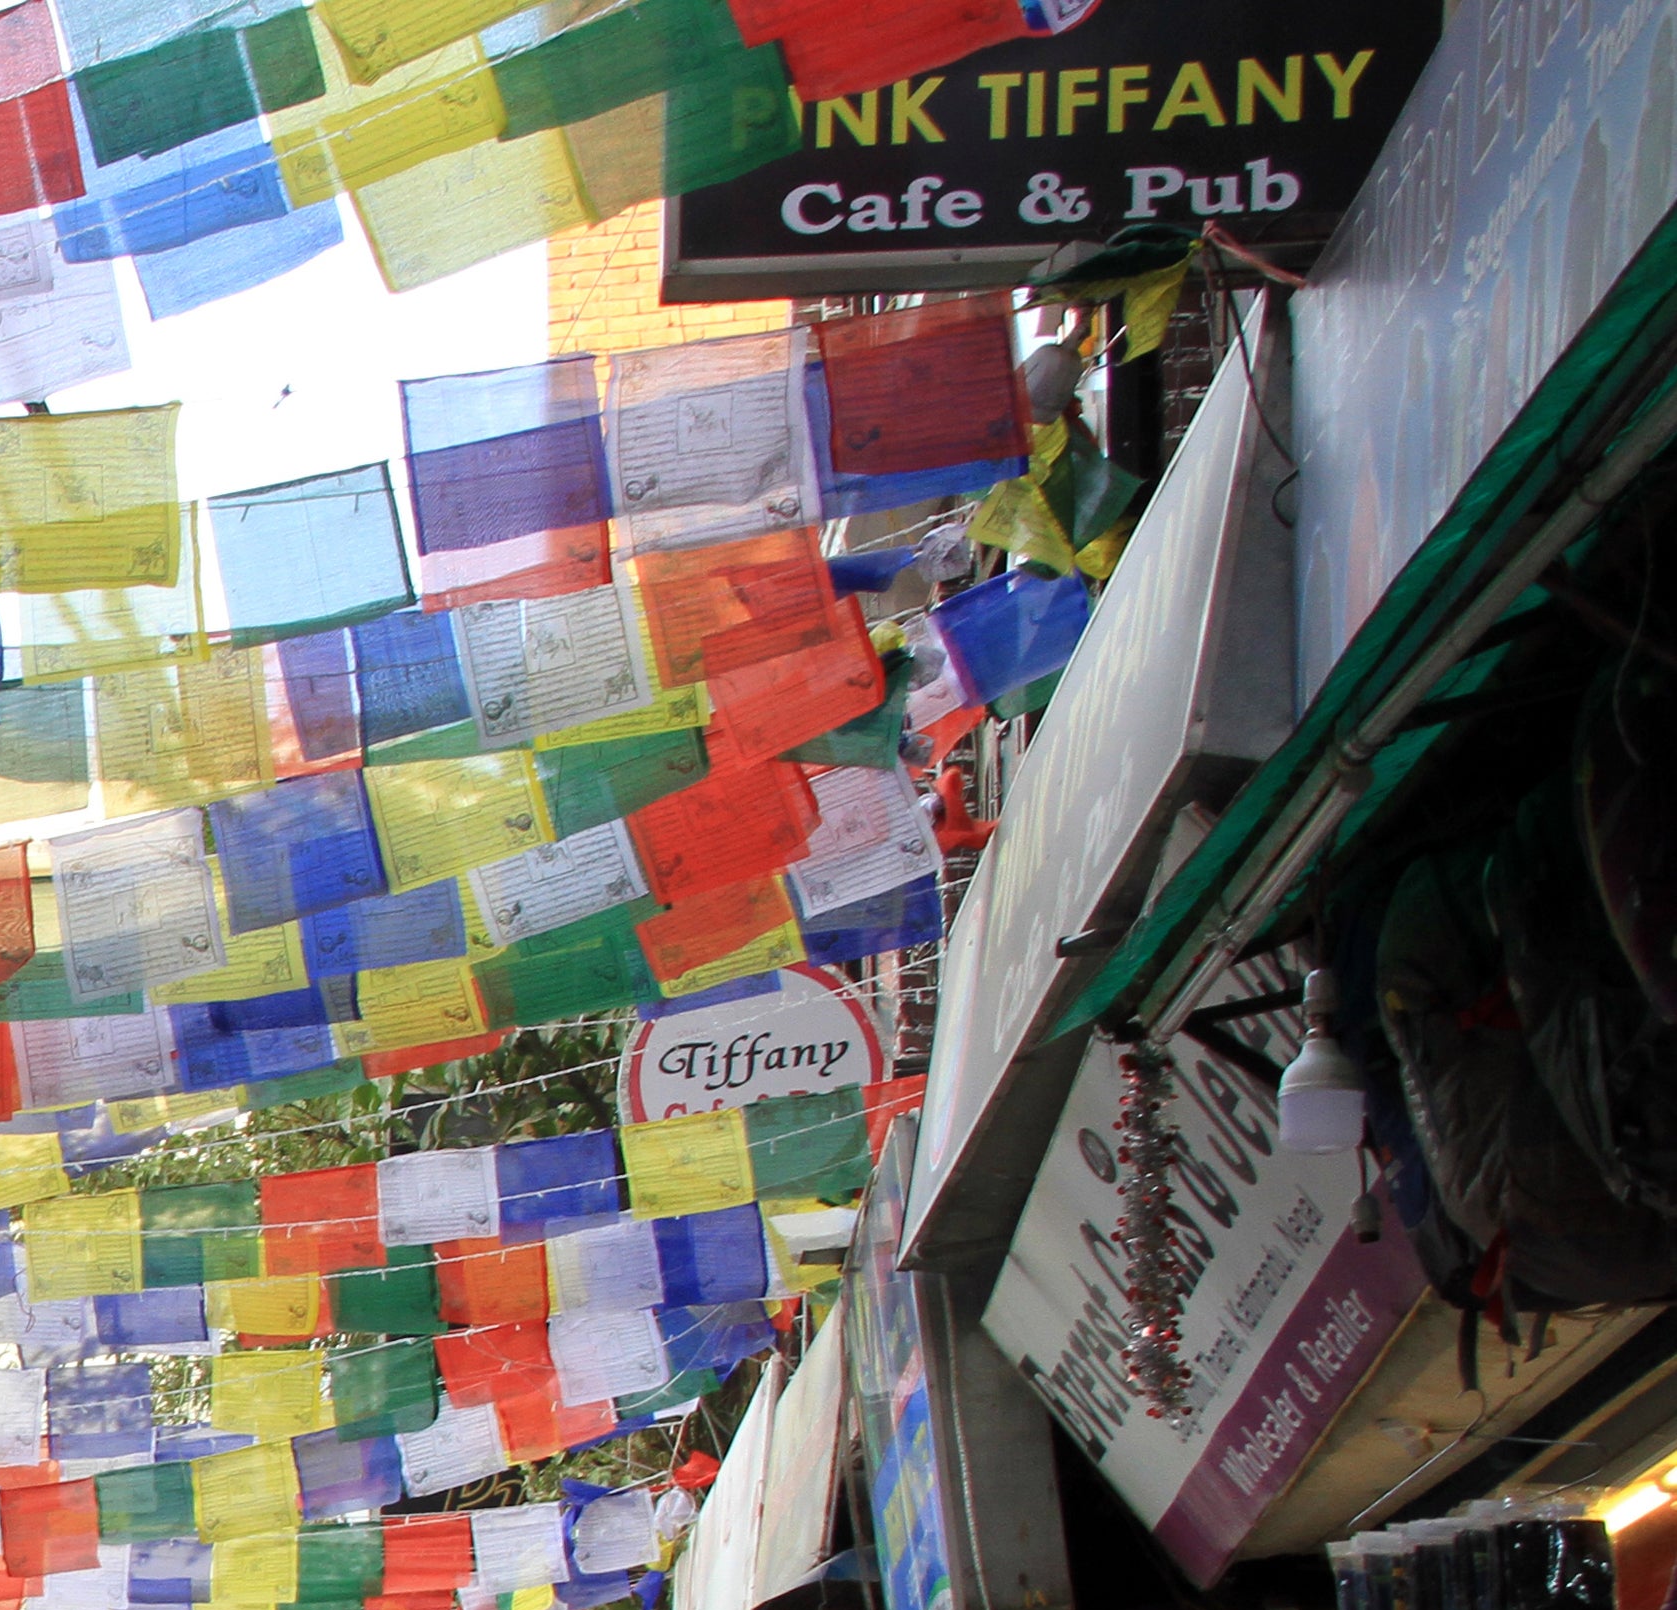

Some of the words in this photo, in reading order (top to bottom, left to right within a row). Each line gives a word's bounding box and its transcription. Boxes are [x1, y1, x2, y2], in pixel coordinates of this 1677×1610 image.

[978, 49, 1375, 141] TIFFANY
[781, 176, 984, 236] Cafe
[1018, 172, 1092, 225] &
[1123, 158, 1303, 220] Pub
[659, 1031, 850, 1091] Tiffany
[1298, 1289, 1375, 1384] Retailer
[1284, 1362, 1322, 1404] &
[1219, 1389, 1307, 1496] Wholesaler
